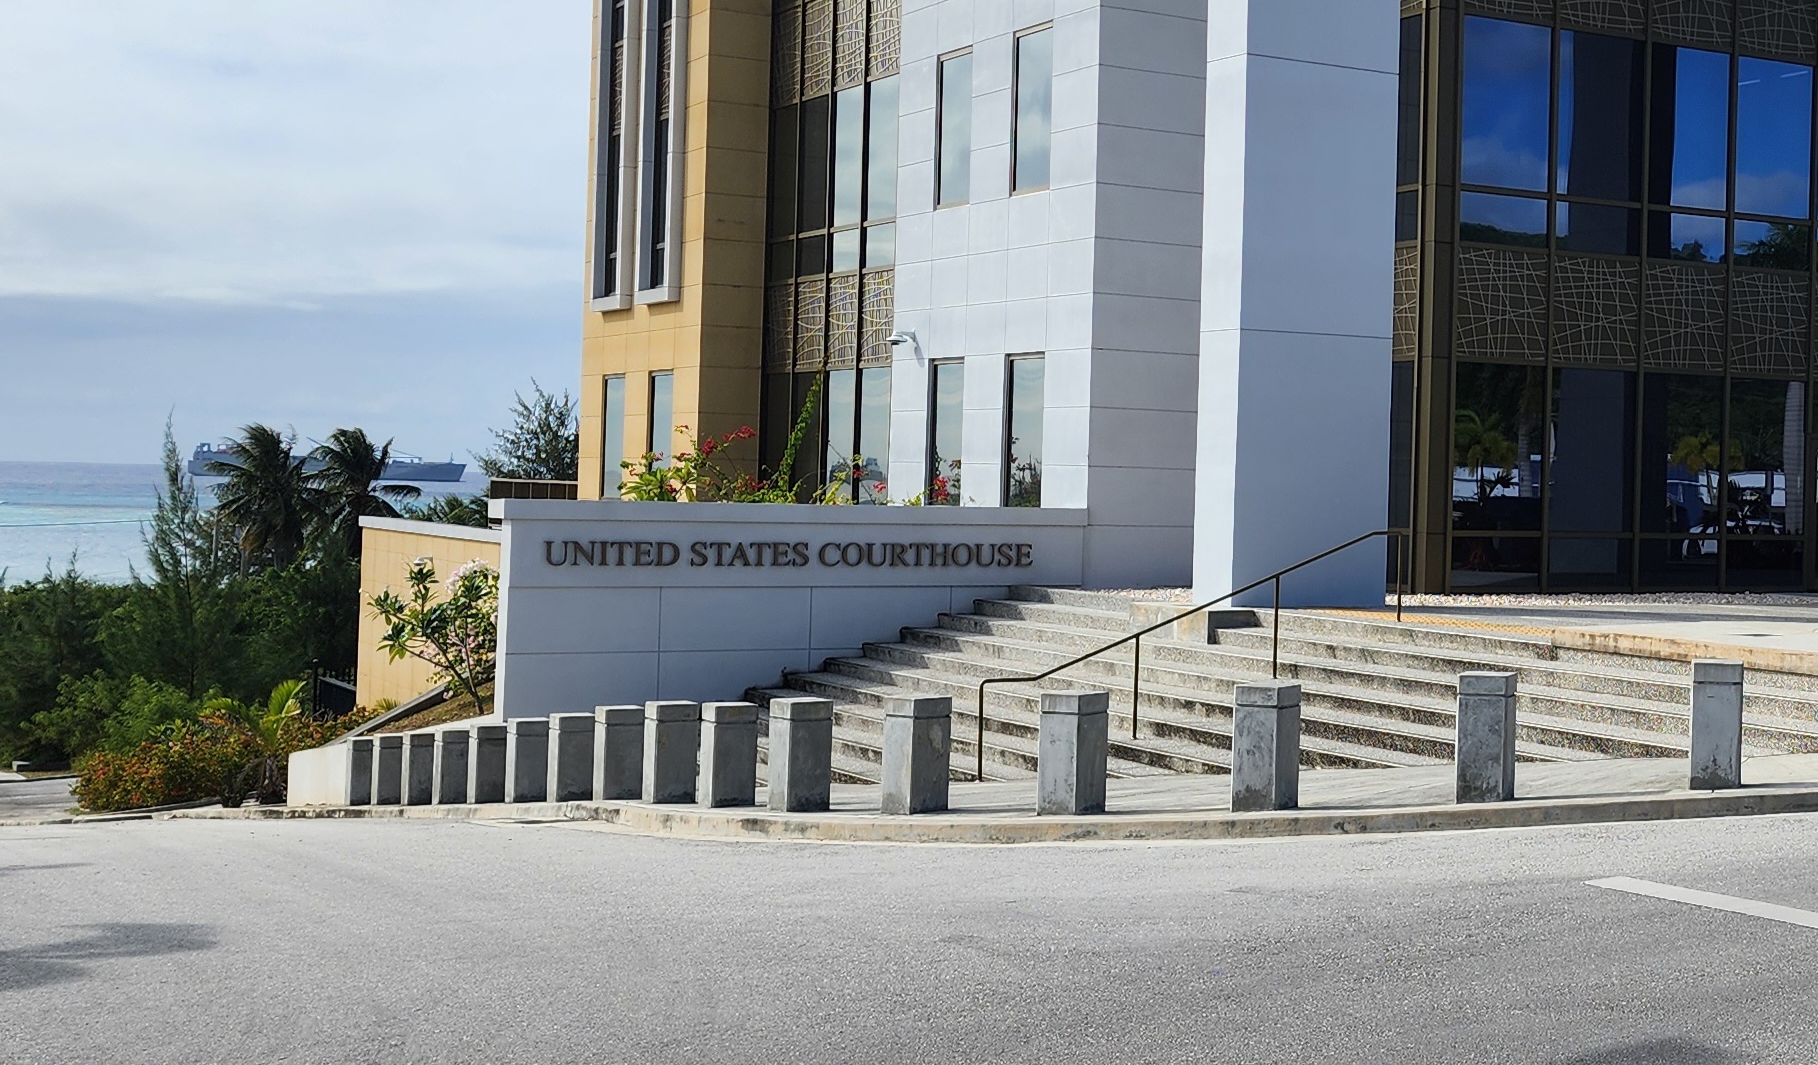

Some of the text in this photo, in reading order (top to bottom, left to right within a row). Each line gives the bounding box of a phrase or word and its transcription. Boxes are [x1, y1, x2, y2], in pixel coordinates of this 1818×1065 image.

[544, 540, 1034, 568] UNITED STATES COURTHOUSE
